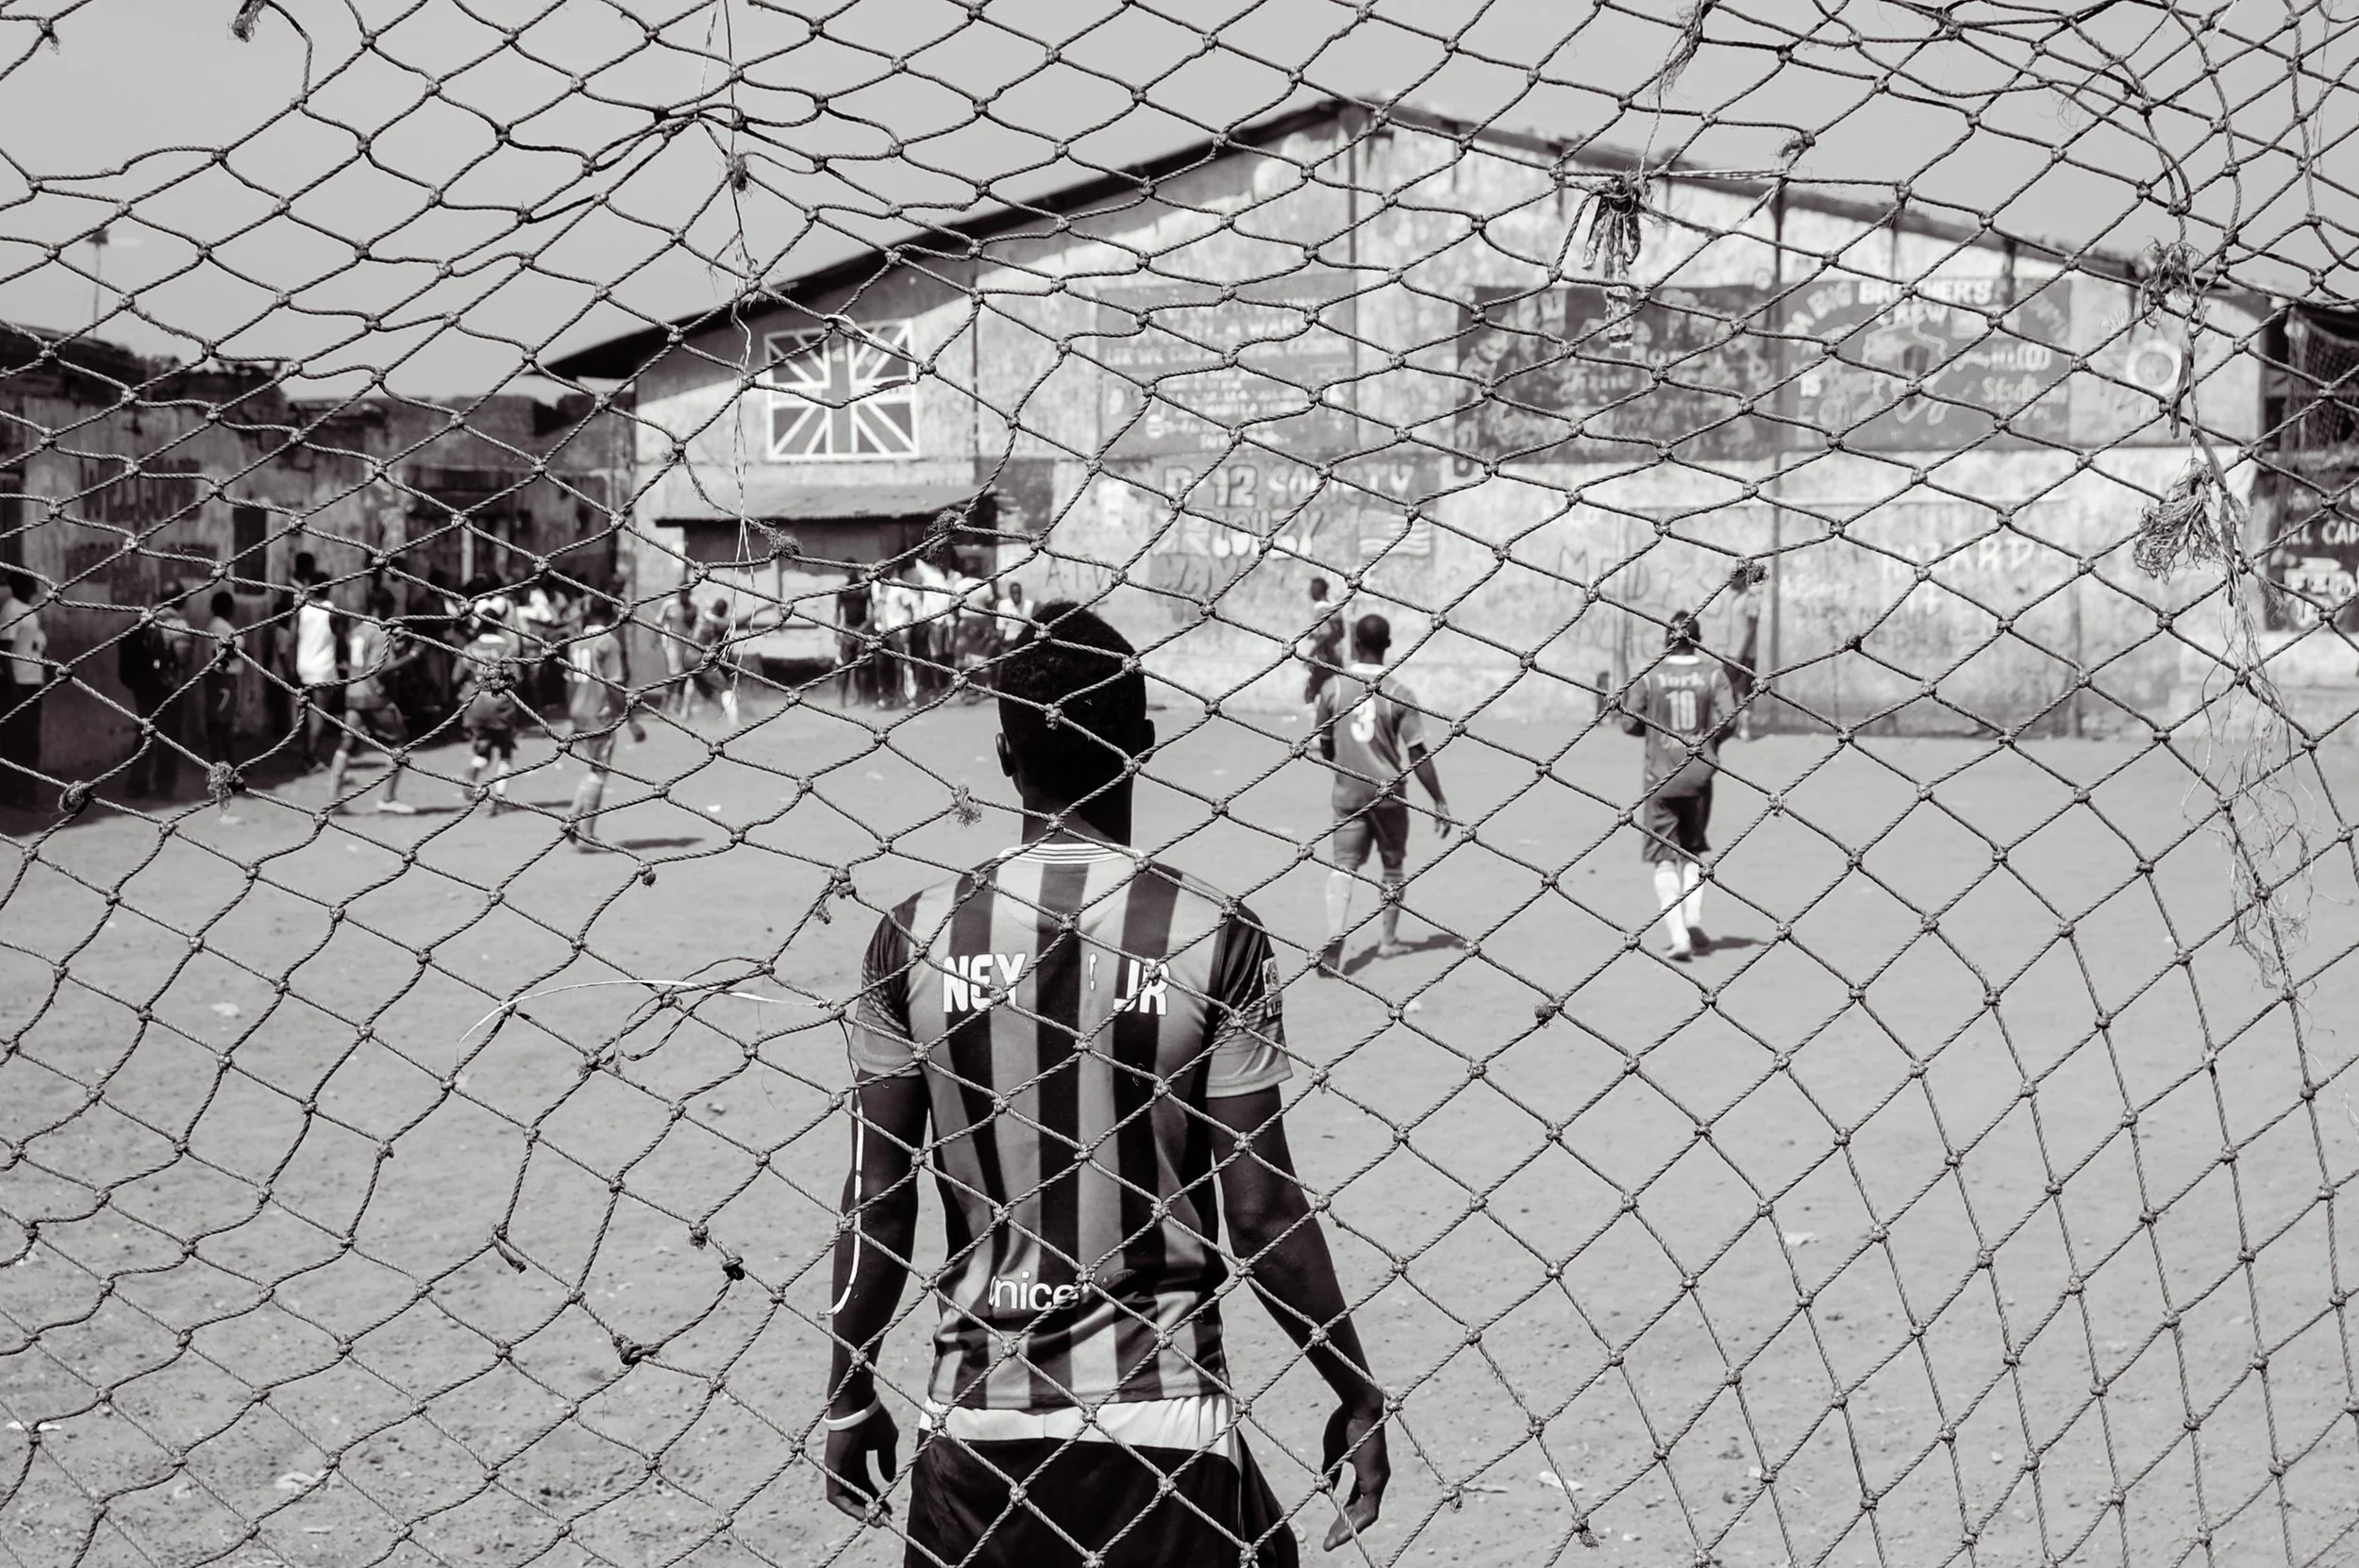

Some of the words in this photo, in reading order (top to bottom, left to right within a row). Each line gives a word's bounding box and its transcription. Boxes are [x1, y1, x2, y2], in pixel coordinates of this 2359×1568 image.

[1211, 465, 1257, 508] 12
[1350, 693, 1377, 743] 3
[1665, 689, 1697, 731] 10
[1113, 958, 1169, 1016] JR
[989, 1271, 1090, 1311] nice
